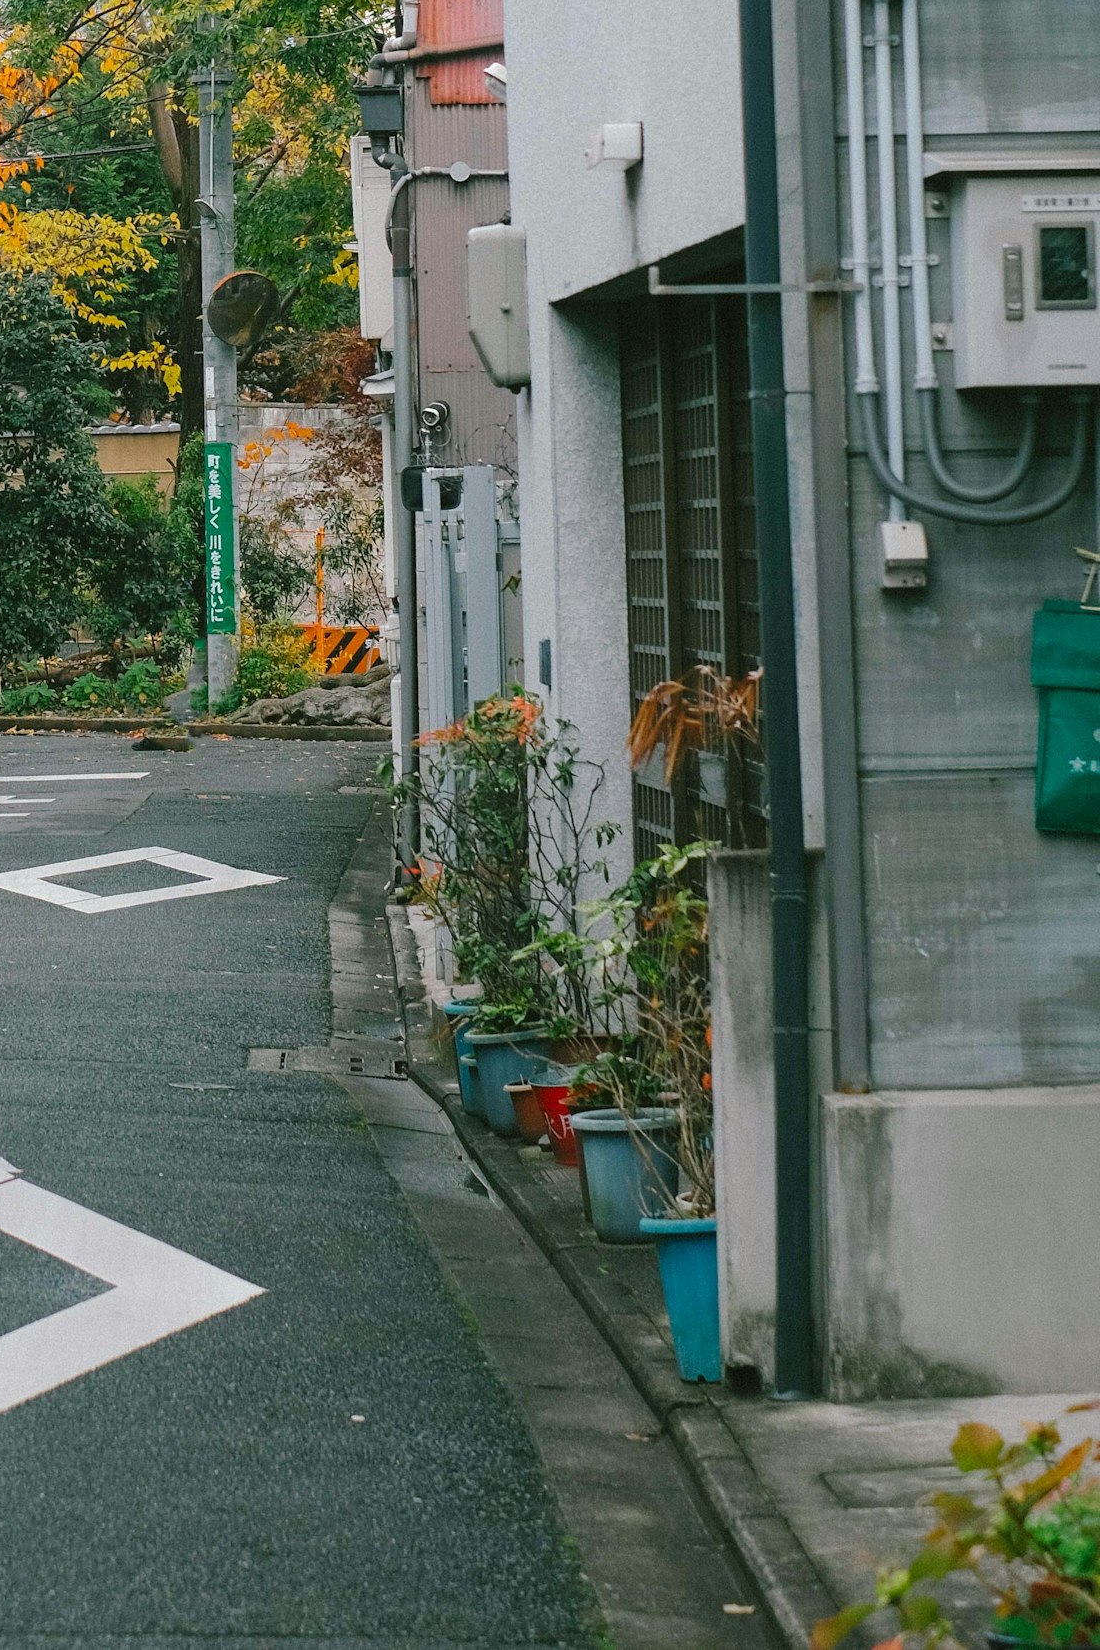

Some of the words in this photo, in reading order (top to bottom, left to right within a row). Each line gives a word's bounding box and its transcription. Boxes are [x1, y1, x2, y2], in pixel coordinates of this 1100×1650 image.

[207, 454, 222, 529] 町を美しく
[209, 534, 224, 622] 川をきれいに
